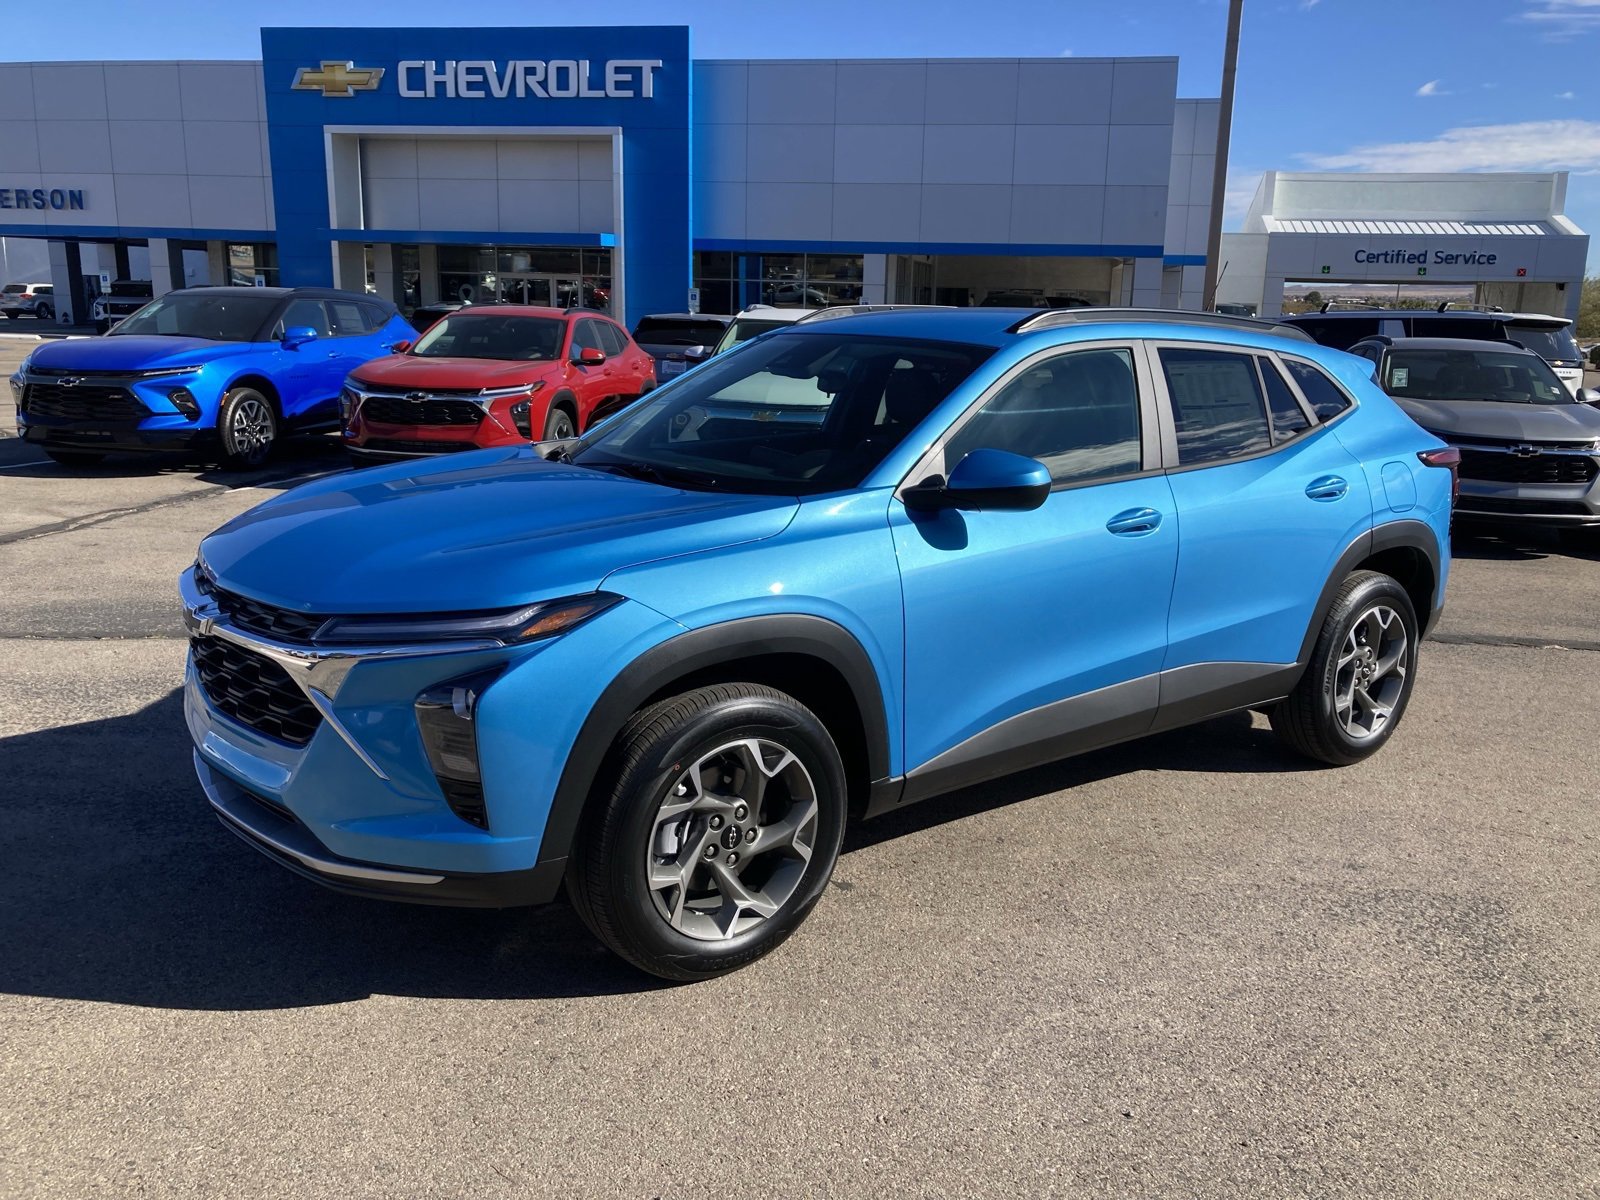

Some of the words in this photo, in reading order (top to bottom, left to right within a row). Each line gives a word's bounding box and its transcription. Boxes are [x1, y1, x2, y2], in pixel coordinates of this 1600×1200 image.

[398, 60, 662, 97] CHEVROLET
[0, 189, 84, 210] ERSON
[1354, 249, 1428, 264] Certified
[1433, 250, 1497, 265] Service
